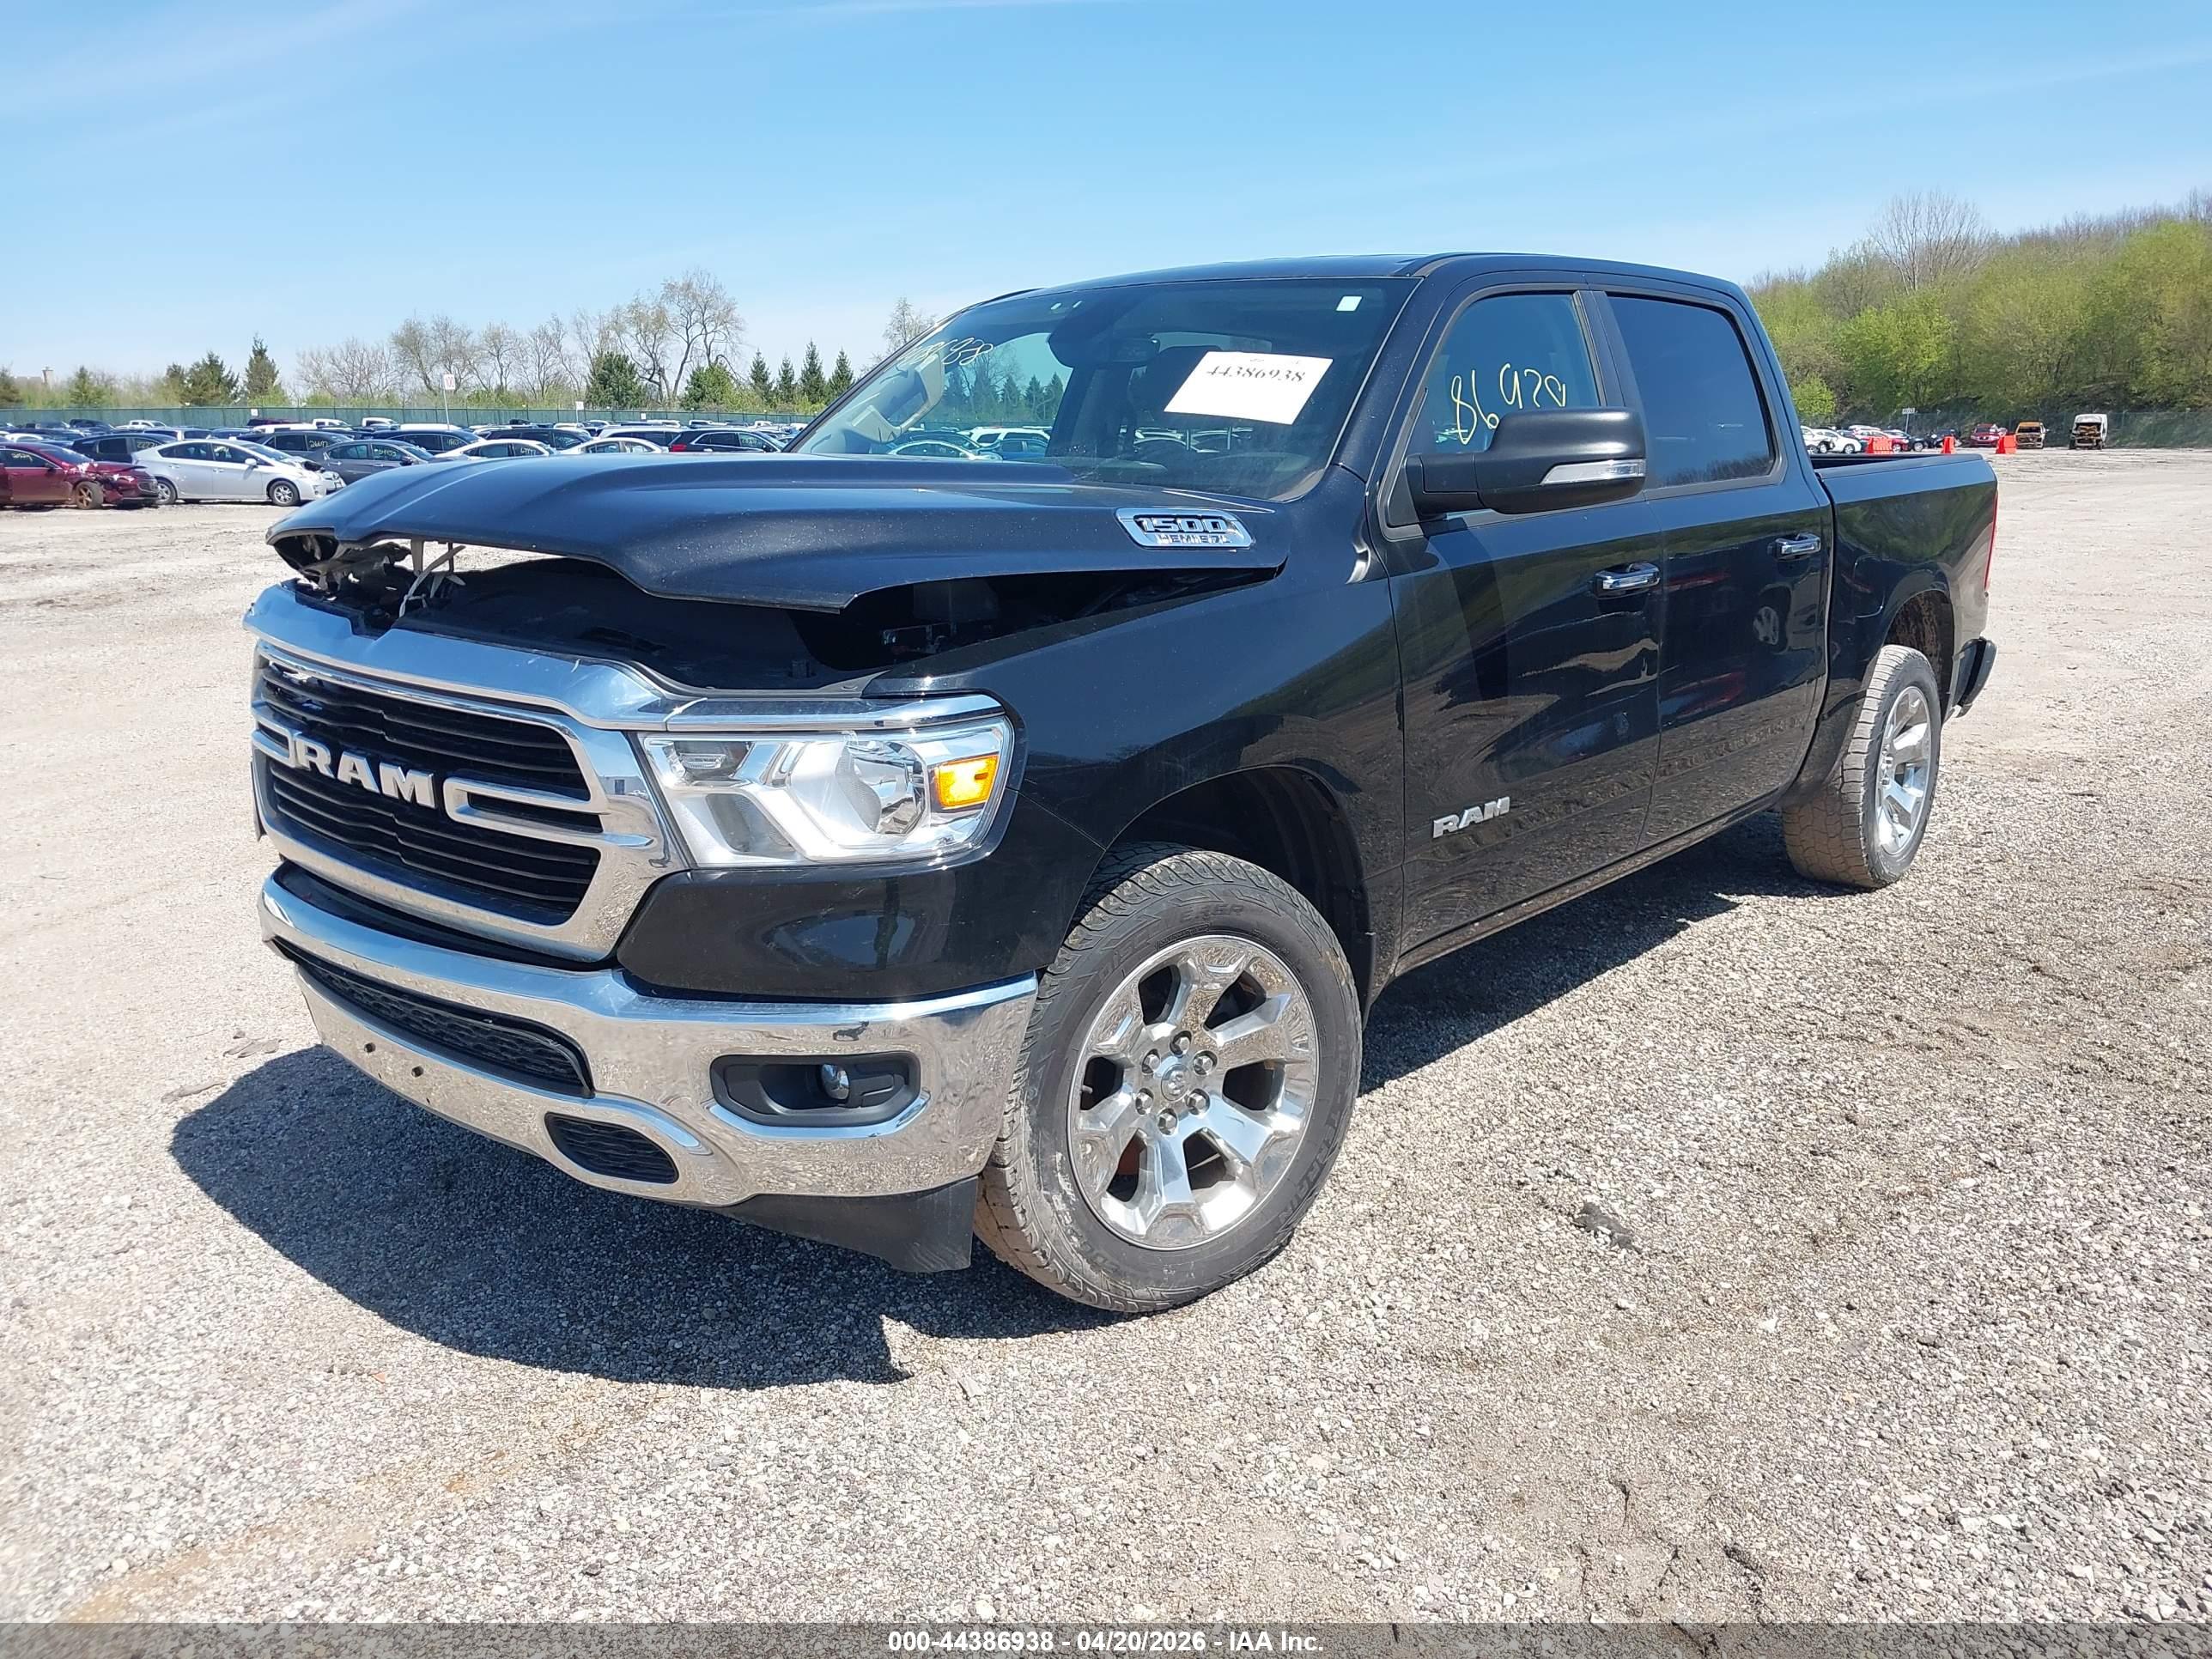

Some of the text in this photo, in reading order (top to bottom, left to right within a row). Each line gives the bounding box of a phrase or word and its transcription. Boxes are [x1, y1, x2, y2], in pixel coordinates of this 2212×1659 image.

[1206, 365, 1306, 383] 44386938
[1135, 517, 1228, 533] 1500
[296, 735, 435, 809] RAM
[1432, 796, 1510, 839] RAM
